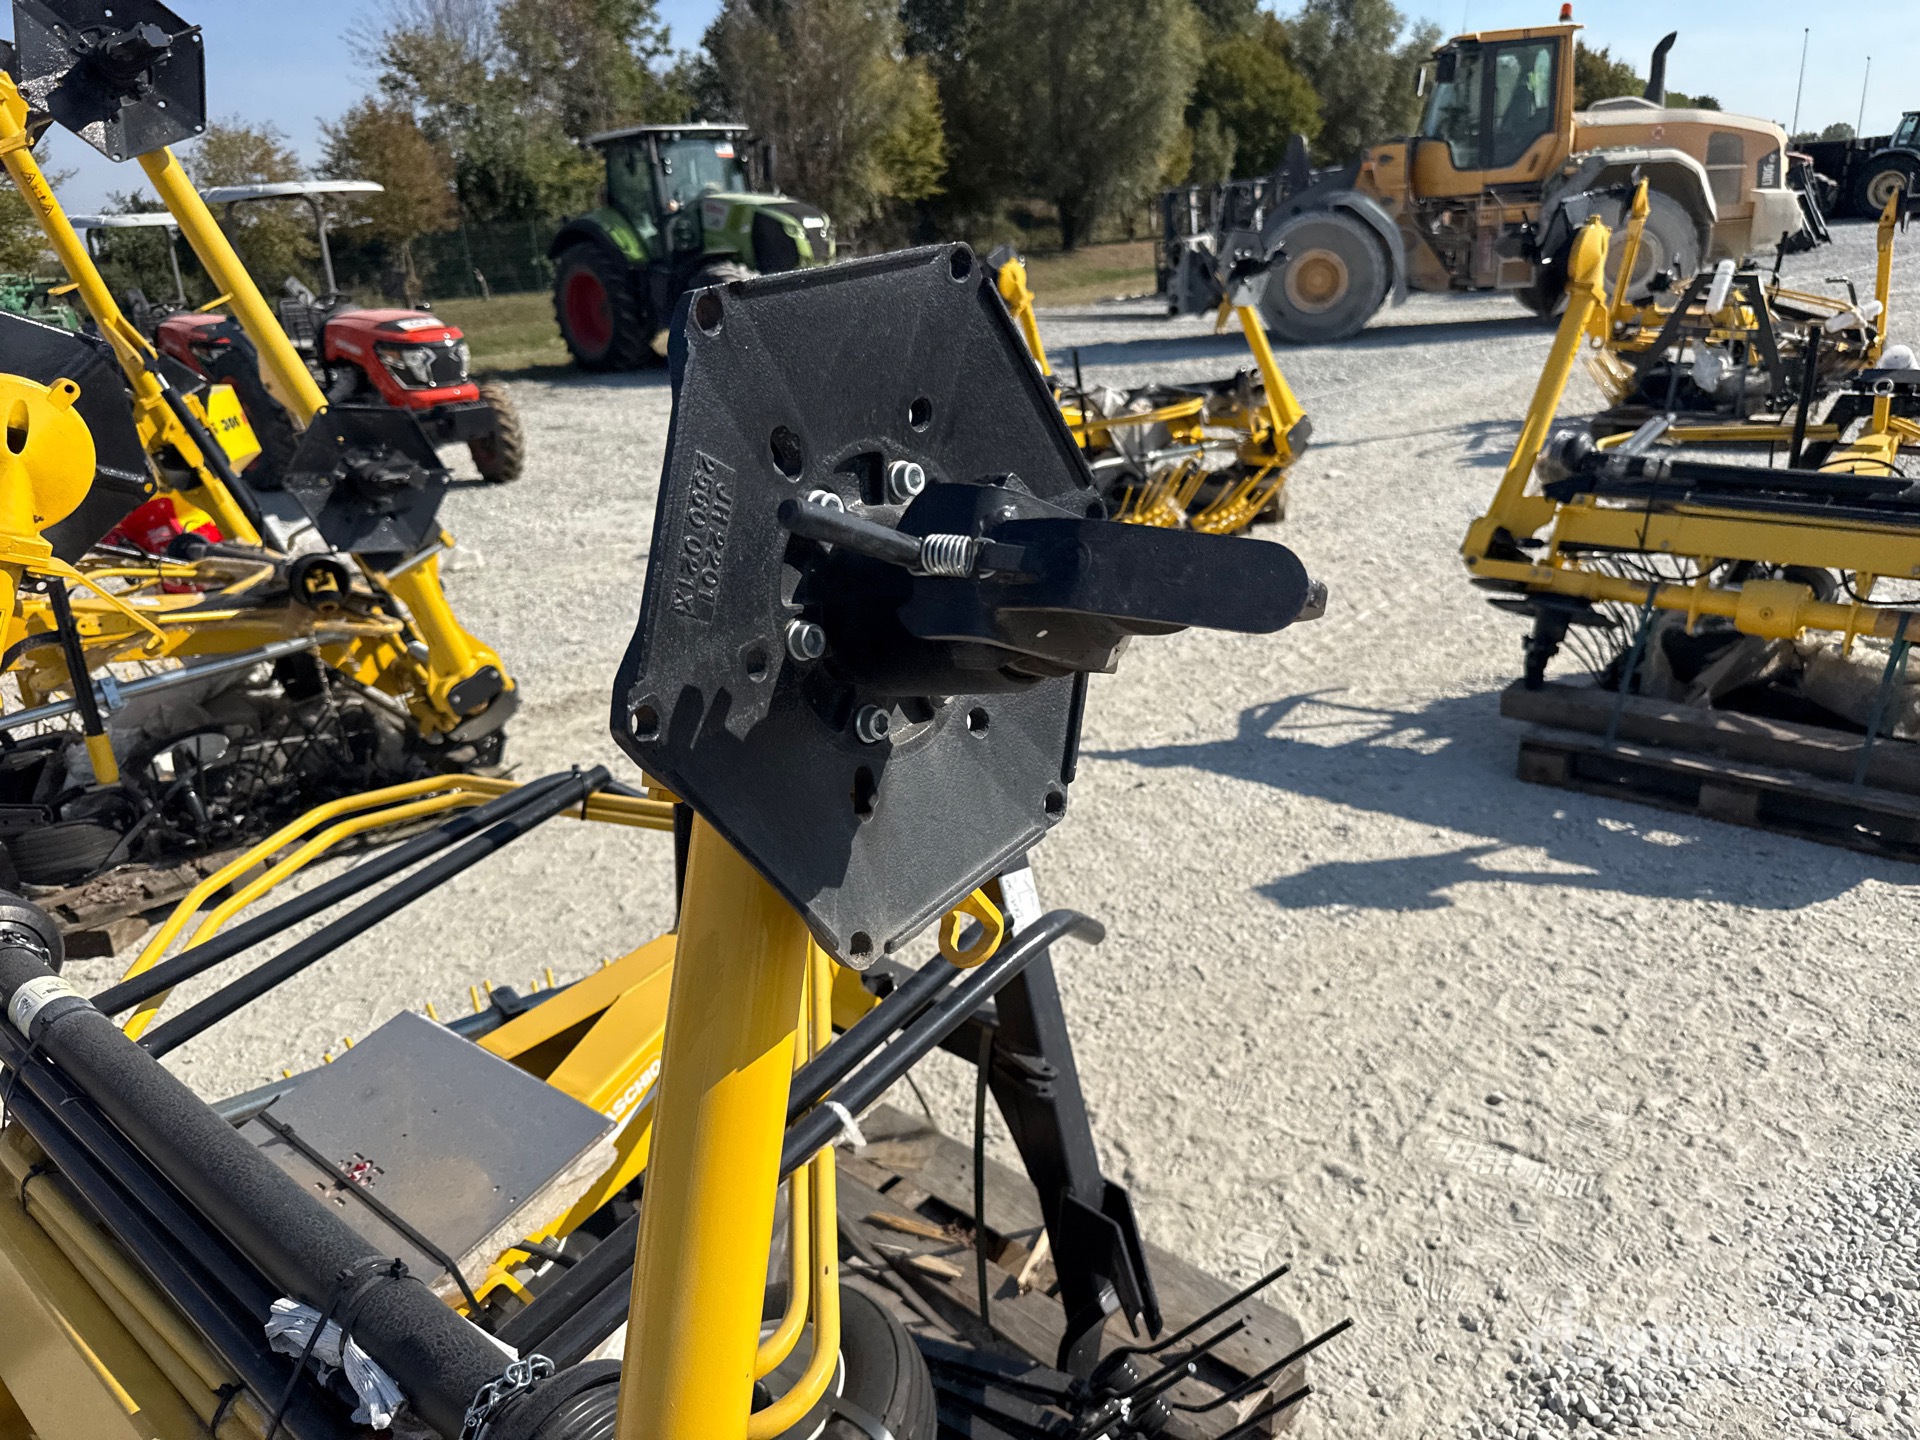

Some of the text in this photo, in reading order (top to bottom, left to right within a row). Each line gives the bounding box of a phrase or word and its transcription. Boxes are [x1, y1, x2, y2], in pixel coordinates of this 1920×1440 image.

[689, 455, 715, 528] 2560
[698, 482, 733, 602] JH 2201
[604, 1059, 661, 1121] SCHIO
